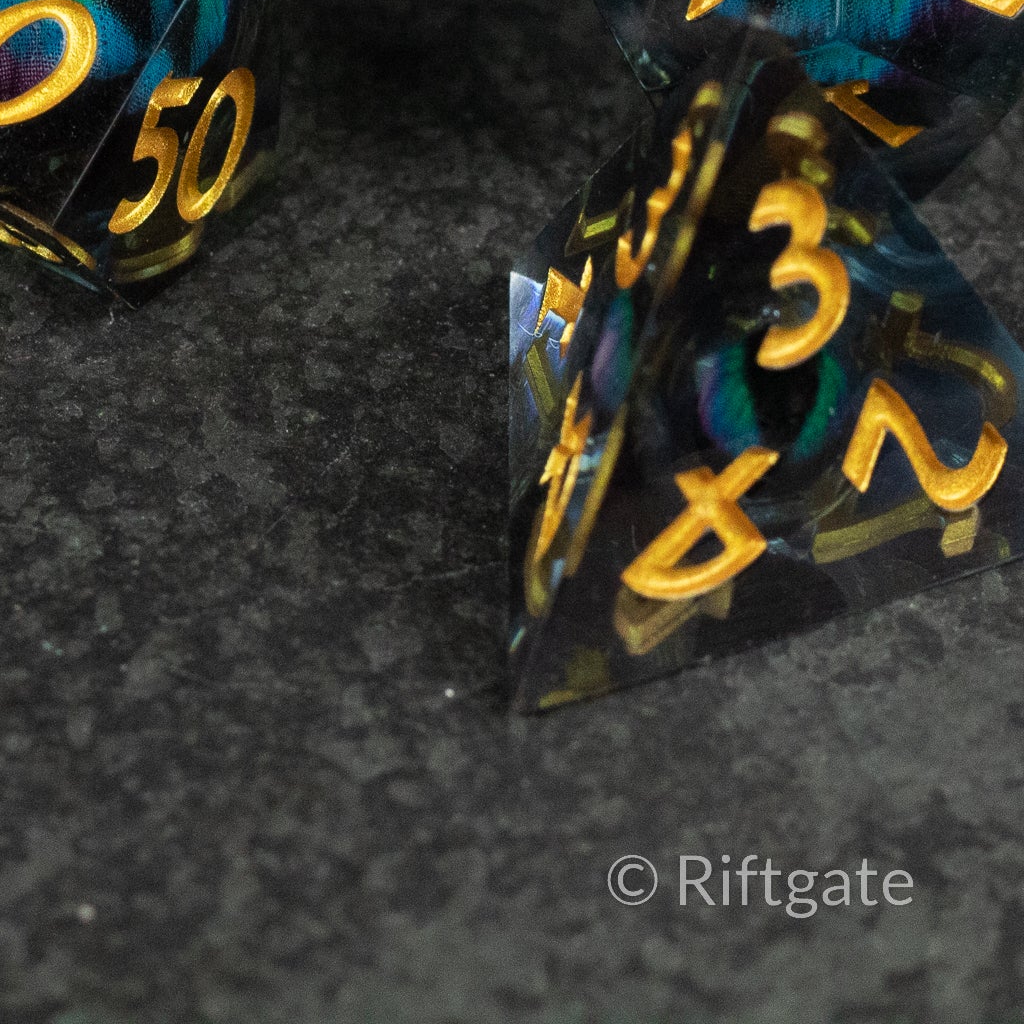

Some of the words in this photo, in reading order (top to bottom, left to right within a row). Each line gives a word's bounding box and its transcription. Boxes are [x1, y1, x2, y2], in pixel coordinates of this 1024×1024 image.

[109, 68, 256, 234] 50
[749, 179, 849, 369] 3
[621, 446, 779, 601] 4
[842, 379, 1008, 511] 2
